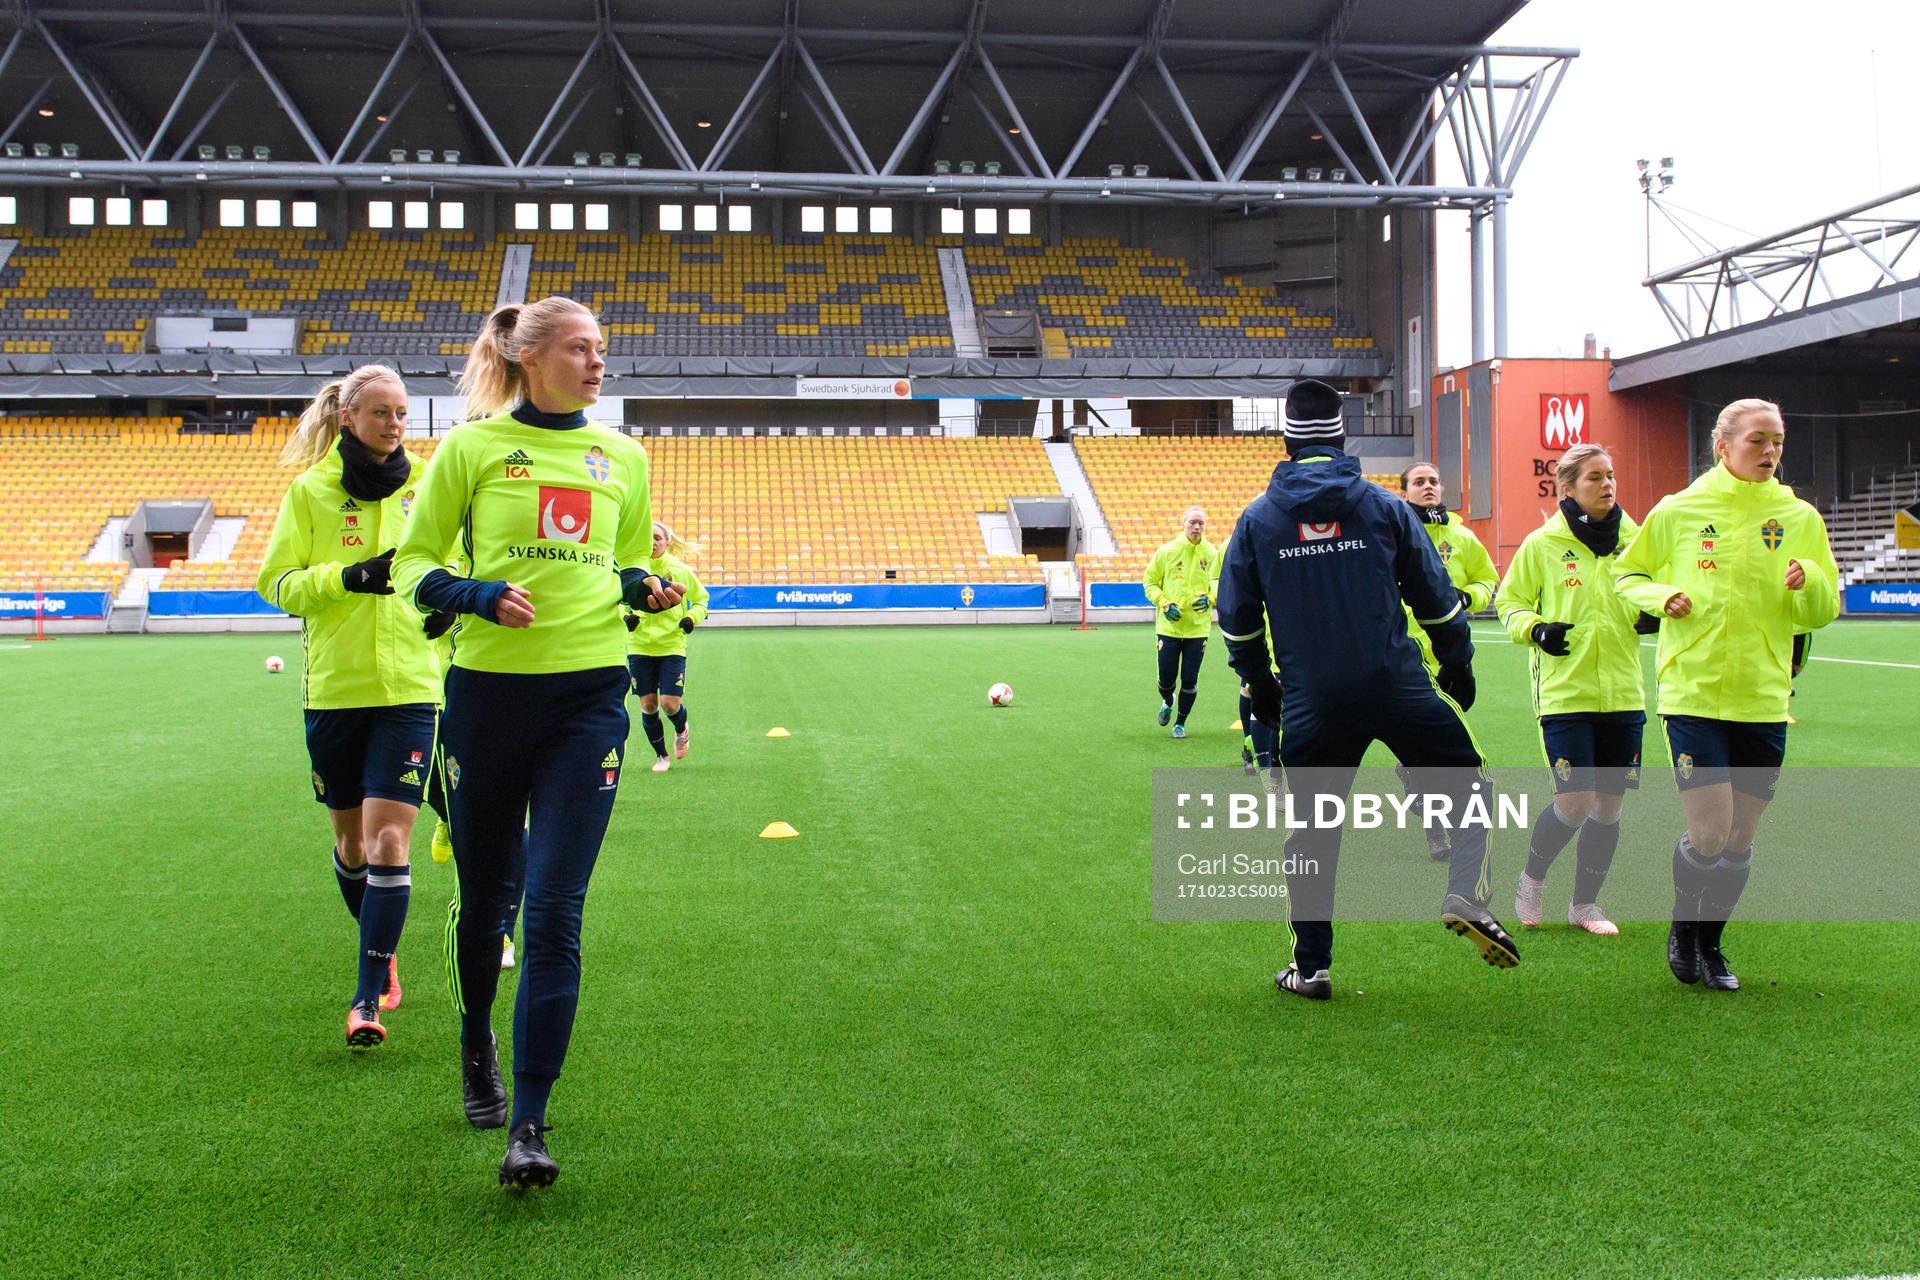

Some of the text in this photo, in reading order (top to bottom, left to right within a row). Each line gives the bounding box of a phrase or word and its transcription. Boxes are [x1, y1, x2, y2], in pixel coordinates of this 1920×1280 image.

[801, 383, 892, 395] Swedbank Sjuhärad
[504, 457, 534, 466] adidas
[505, 466, 531, 478] ICA
[341, 535, 364, 547] ICA
[1279, 539, 1367, 559] SVENSKA SPEL
[508, 546, 605, 566] SVENSKA SPEL
[1697, 559, 1718, 570] ICA
[1565, 578, 1582, 588] ICA
[776, 591, 853, 604] #viärsverige
